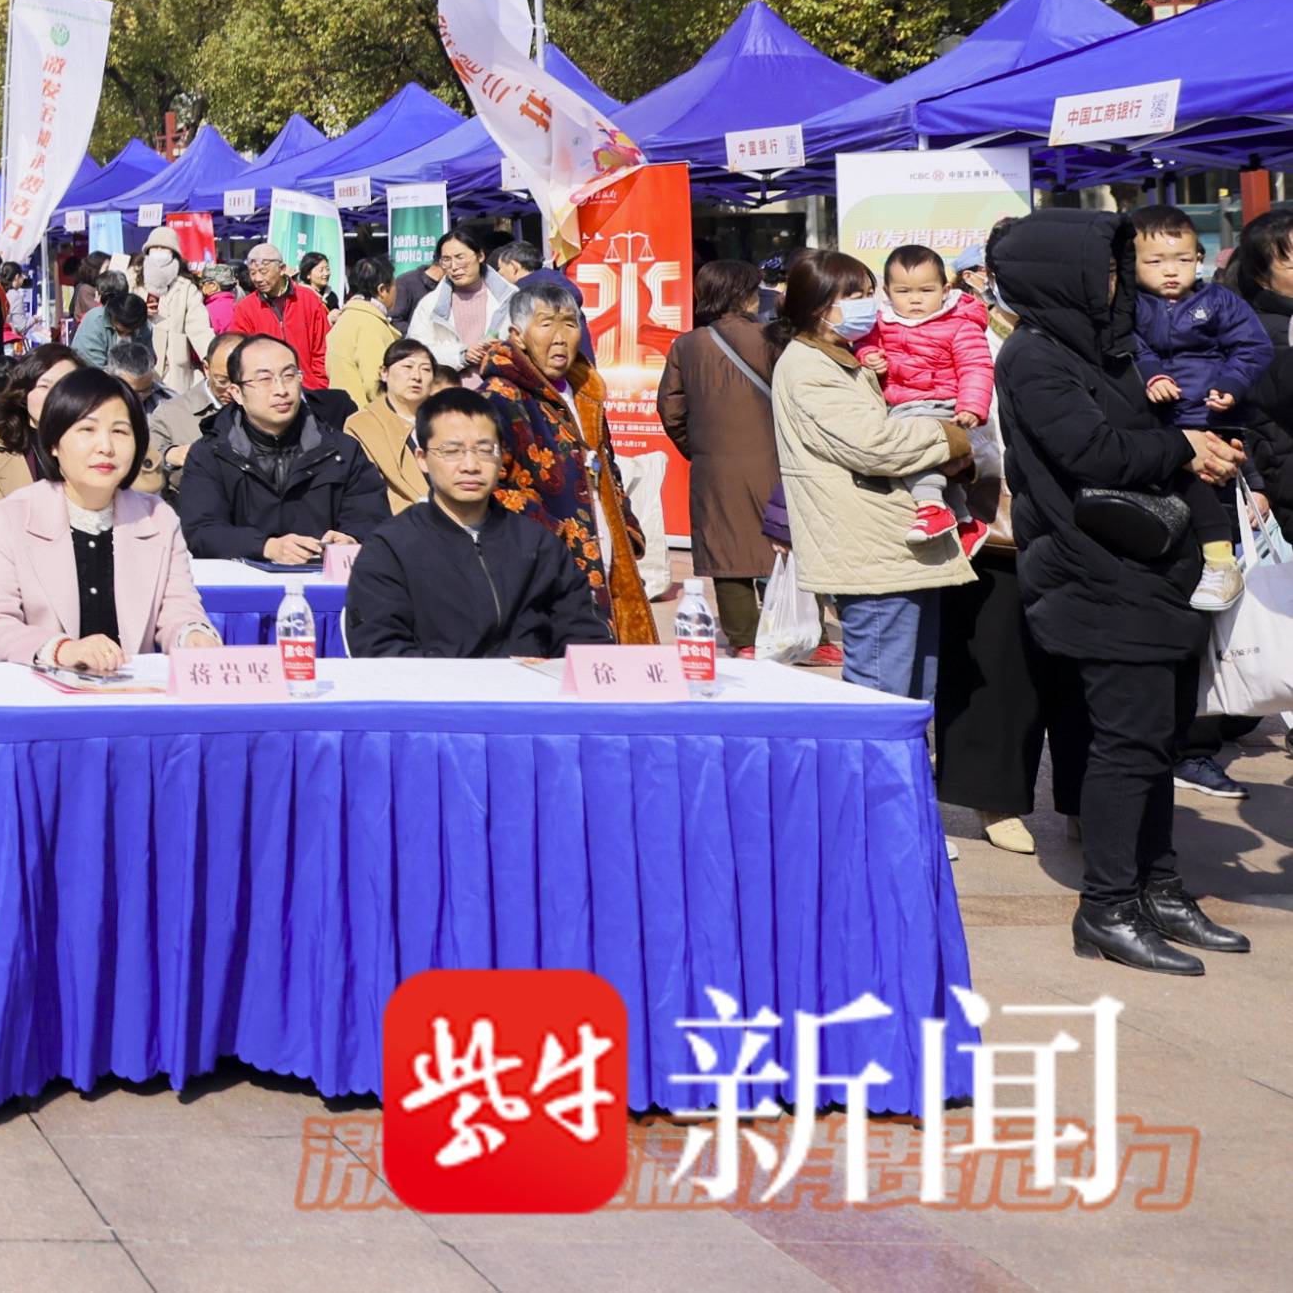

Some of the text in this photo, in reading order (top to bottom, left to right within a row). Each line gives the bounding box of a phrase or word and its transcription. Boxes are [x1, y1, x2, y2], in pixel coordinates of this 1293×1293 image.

[1067, 99, 1142, 128] 中国工商银行
[738, 138, 779, 157] 中国银行
[948, 169, 1000, 180] 中国工商银行
